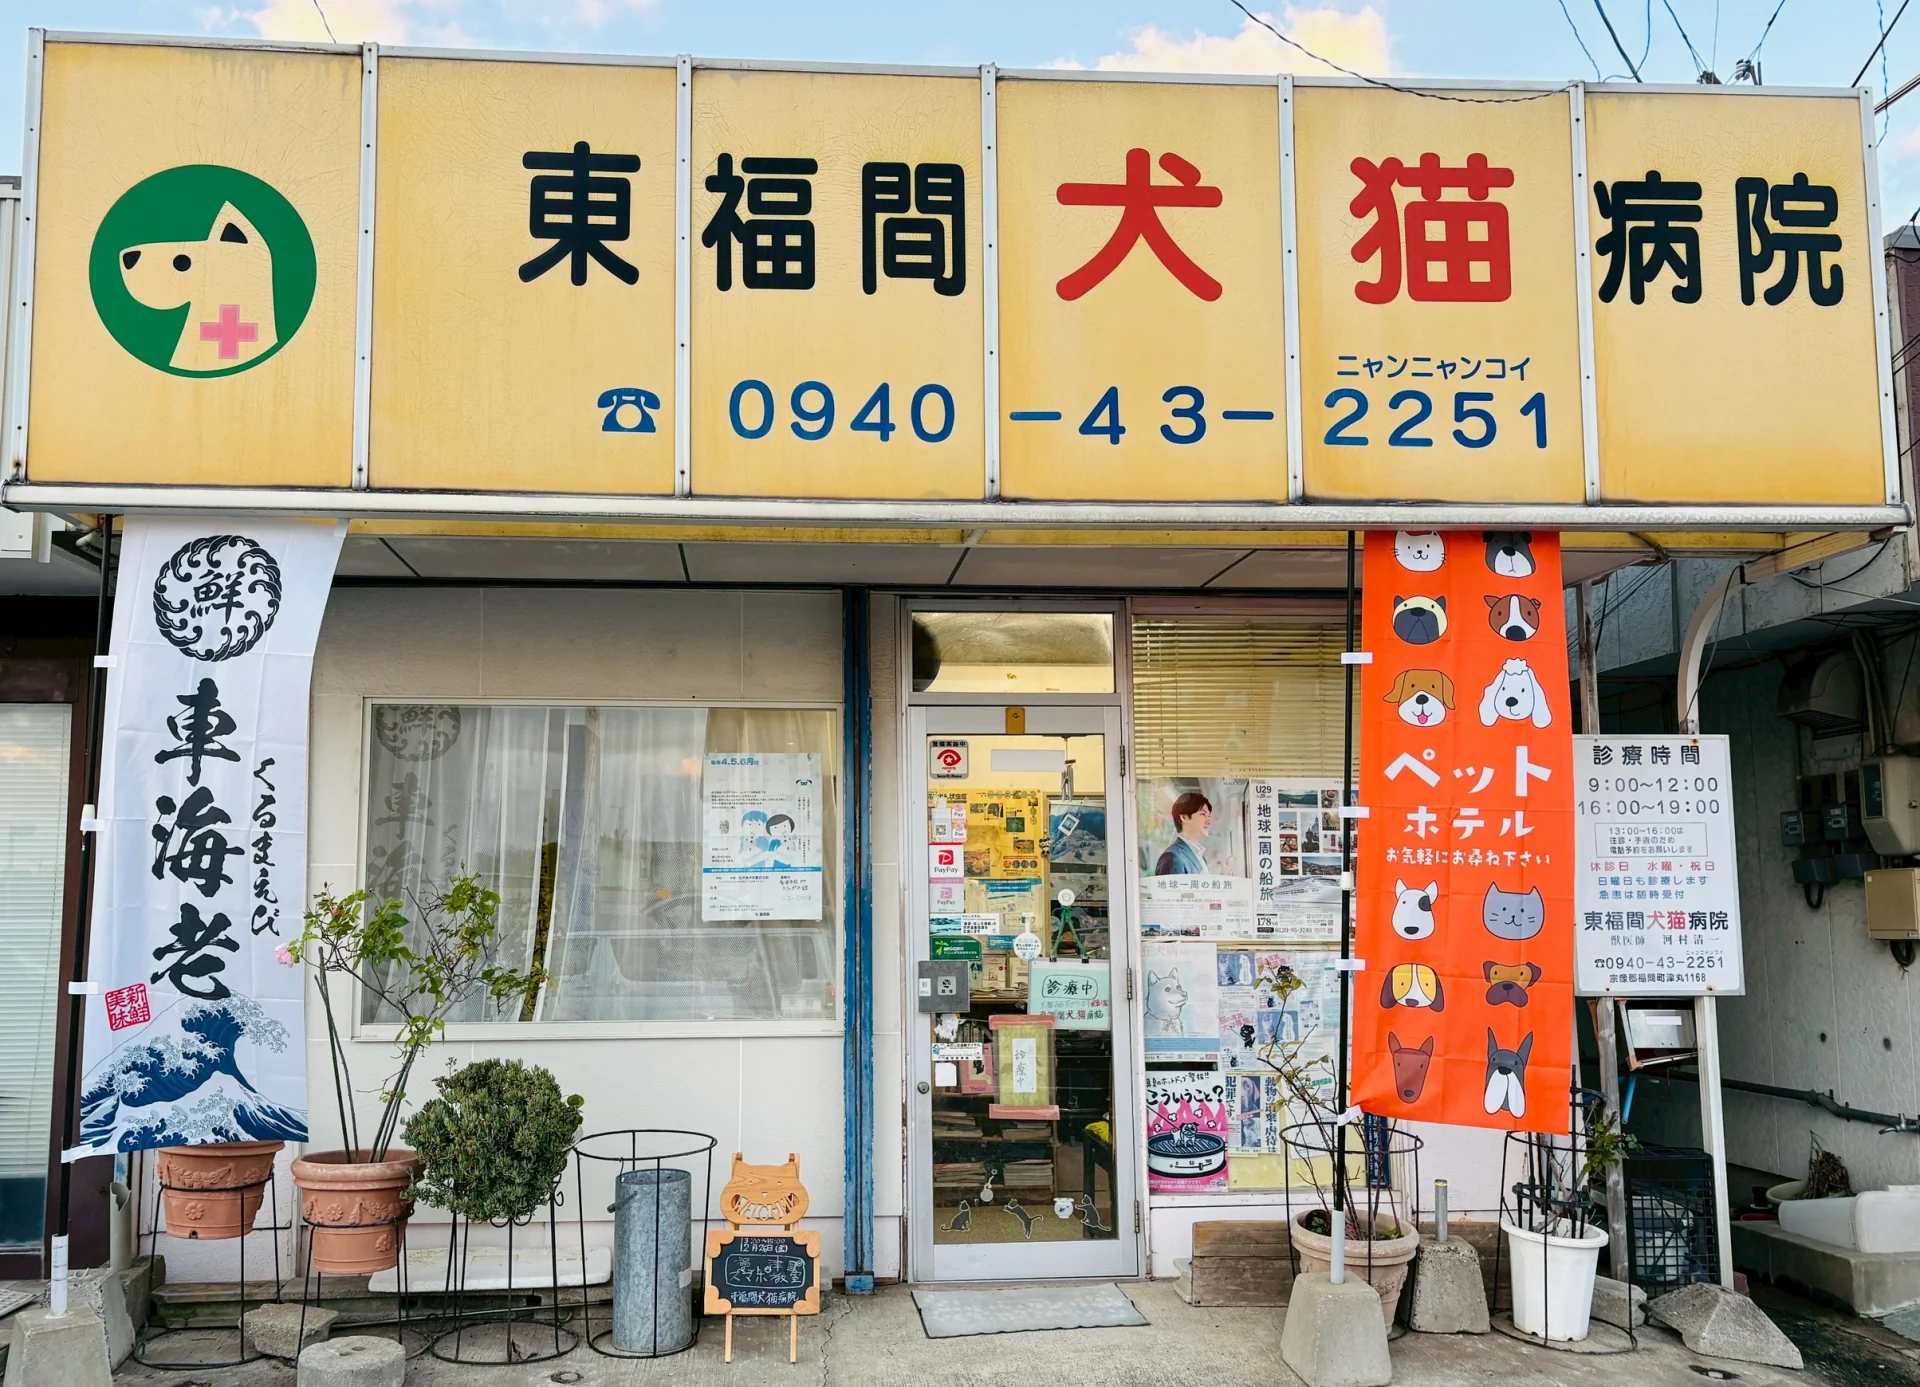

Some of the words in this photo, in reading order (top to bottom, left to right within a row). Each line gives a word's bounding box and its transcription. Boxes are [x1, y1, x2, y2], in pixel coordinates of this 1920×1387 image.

[518, 141, 1844, 306] 東福間犬猫病院
[1337, 355, 1530, 381] ニャンニャンコイ
[191, 570, 244, 627] 鮮
[1593, 745, 1700, 766] 診療時間
[1384, 746, 1552, 797] ペット
[1255, 786, 1272, 794] U29
[1589, 778, 1718, 792] 9:00～12:00
[1578, 800, 1720, 815] 16:00～19:00
[1403, 806, 1535, 840] ホテル
[1609, 827, 1684, 836] 13:00～16:00は
[150, 678, 245, 1001] 車海老
[250, 758, 280, 937] くるまえび
[1609, 837, 1675, 845] 往診・手術のため
[1257, 803, 1274, 901] 地球一周の船旅
[1386, 847, 1549, 867] お気軽にお尋ね下さい
[1609, 846, 1693, 855] 電話予約をお願いします
[1590, 861, 1629, 872] 休診日
[1647, 861, 1715, 872] 水曜・祝日
[1158, 880, 1233, 890] 地球一周の船旅
[1598, 876, 1709, 886] 日曜日も診療します
[1599, 890, 1685, 900] 急患は随時受付
[1257, 918, 1272, 926] 178
[1584, 910, 1729, 931] 東福間犬猫病院
[1610, 935, 1646, 946] 獣医師
[1663, 934, 1720, 946] 河村清一
[1606, 956, 1724, 969] 0940-43-2251
[1610, 973, 1706, 984] 宗像郡福間町津丸1168
[1046, 979, 1093, 996] 診療中
[1014, 1049, 1027, 1088] 診療中
[1146, 1085, 1224, 1106] こういうこと?
[1225, 1075, 1237, 1121] 犯罪です。
